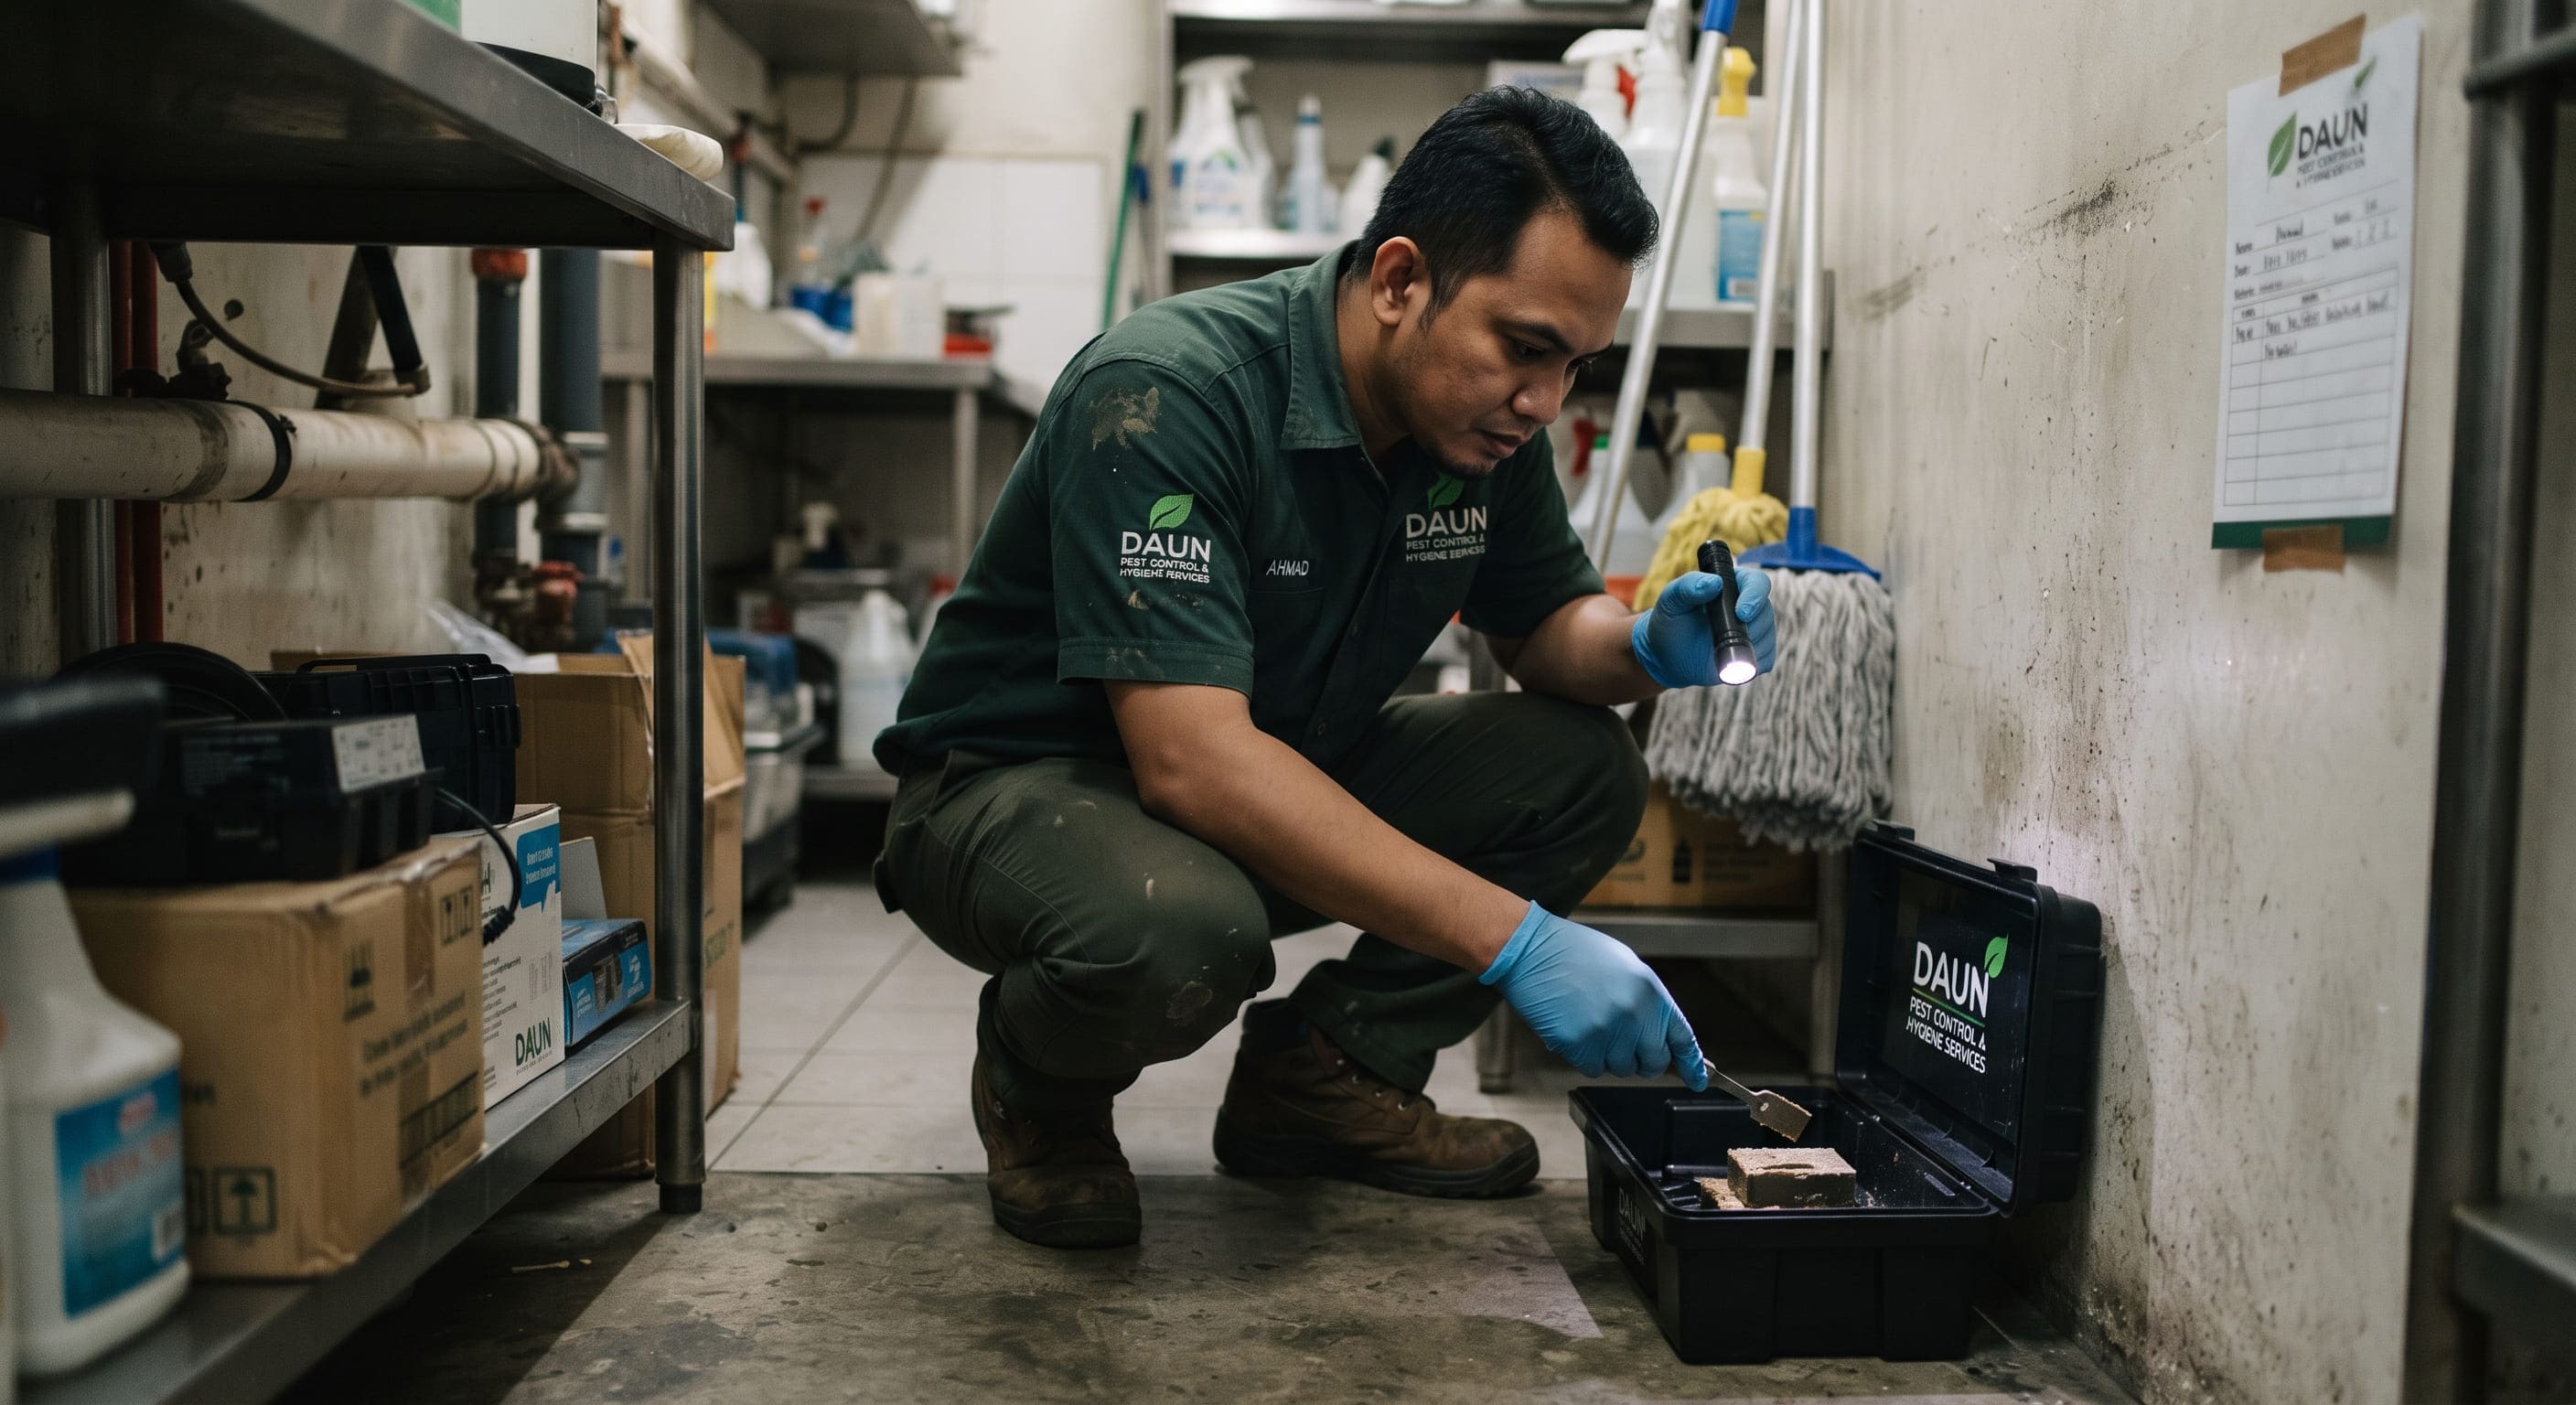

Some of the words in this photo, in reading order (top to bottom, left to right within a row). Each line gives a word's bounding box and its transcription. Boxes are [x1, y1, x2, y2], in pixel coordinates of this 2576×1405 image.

[2298, 102, 2368, 160] DAUN
[1406, 506, 1487, 539] DAUN
[1121, 531, 1211, 563] DAUN
[1121, 557, 1147, 566] PEST
[1150, 559, 1200, 572] CONTROL
[1201, 563, 1209, 573] &
[1406, 540, 1431, 551] PEST
[1265, 559, 1310, 576] AHMAD
[1914, 941, 1990, 1018] DAUN
[515, 1016, 552, 1067] DAUN
[1910, 996, 1933, 1021] PEST
[1934, 1009, 1976, 1046] CONTROL
[1905, 1016, 1944, 1051] HYGIENE
[1944, 1036, 1987, 1074] SERVICES
